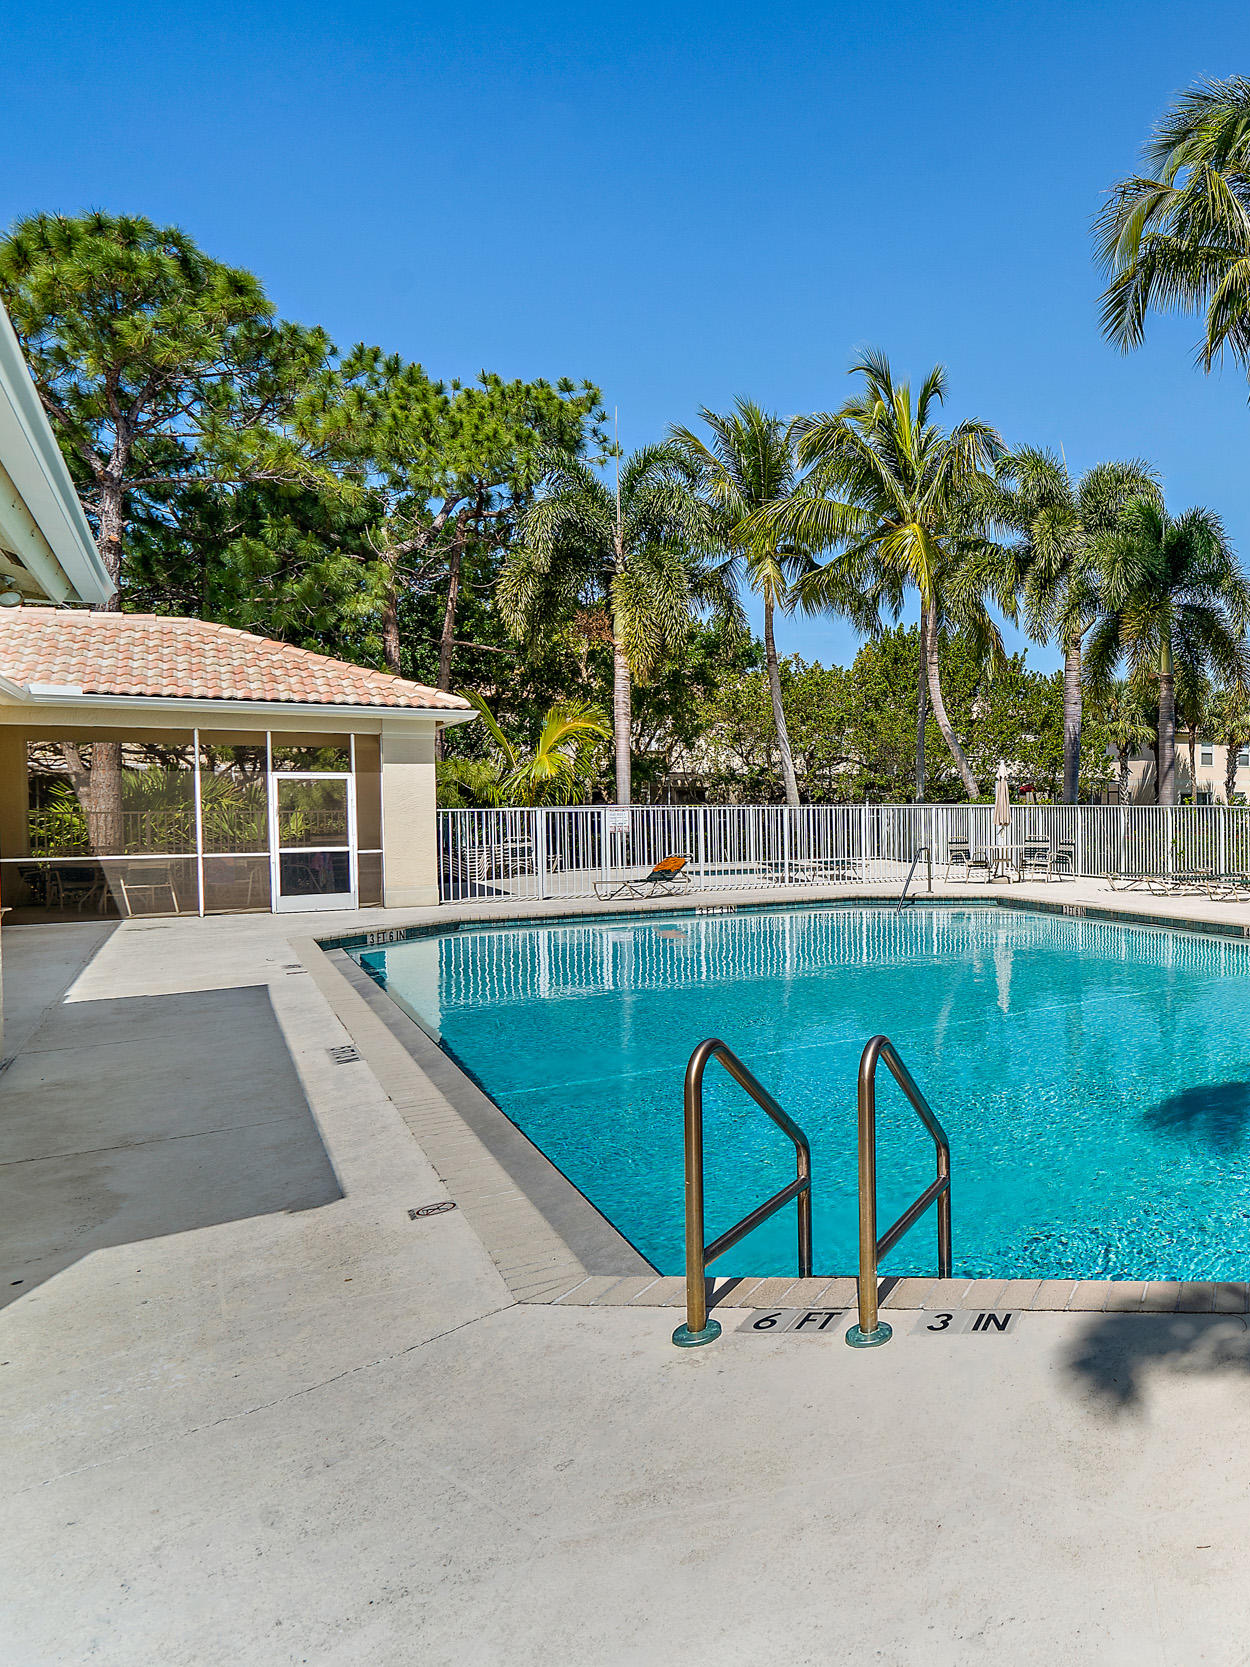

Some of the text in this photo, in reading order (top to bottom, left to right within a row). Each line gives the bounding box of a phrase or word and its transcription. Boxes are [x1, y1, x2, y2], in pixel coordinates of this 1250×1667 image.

[706, 906, 717, 915] FT
[727, 905, 736, 914] IN
[369, 929, 406, 944] 3 FT 6 IN
[1245, 927, 1250, 939] 4
[752, 1312, 1012, 1331] 6 FT 3 IN
